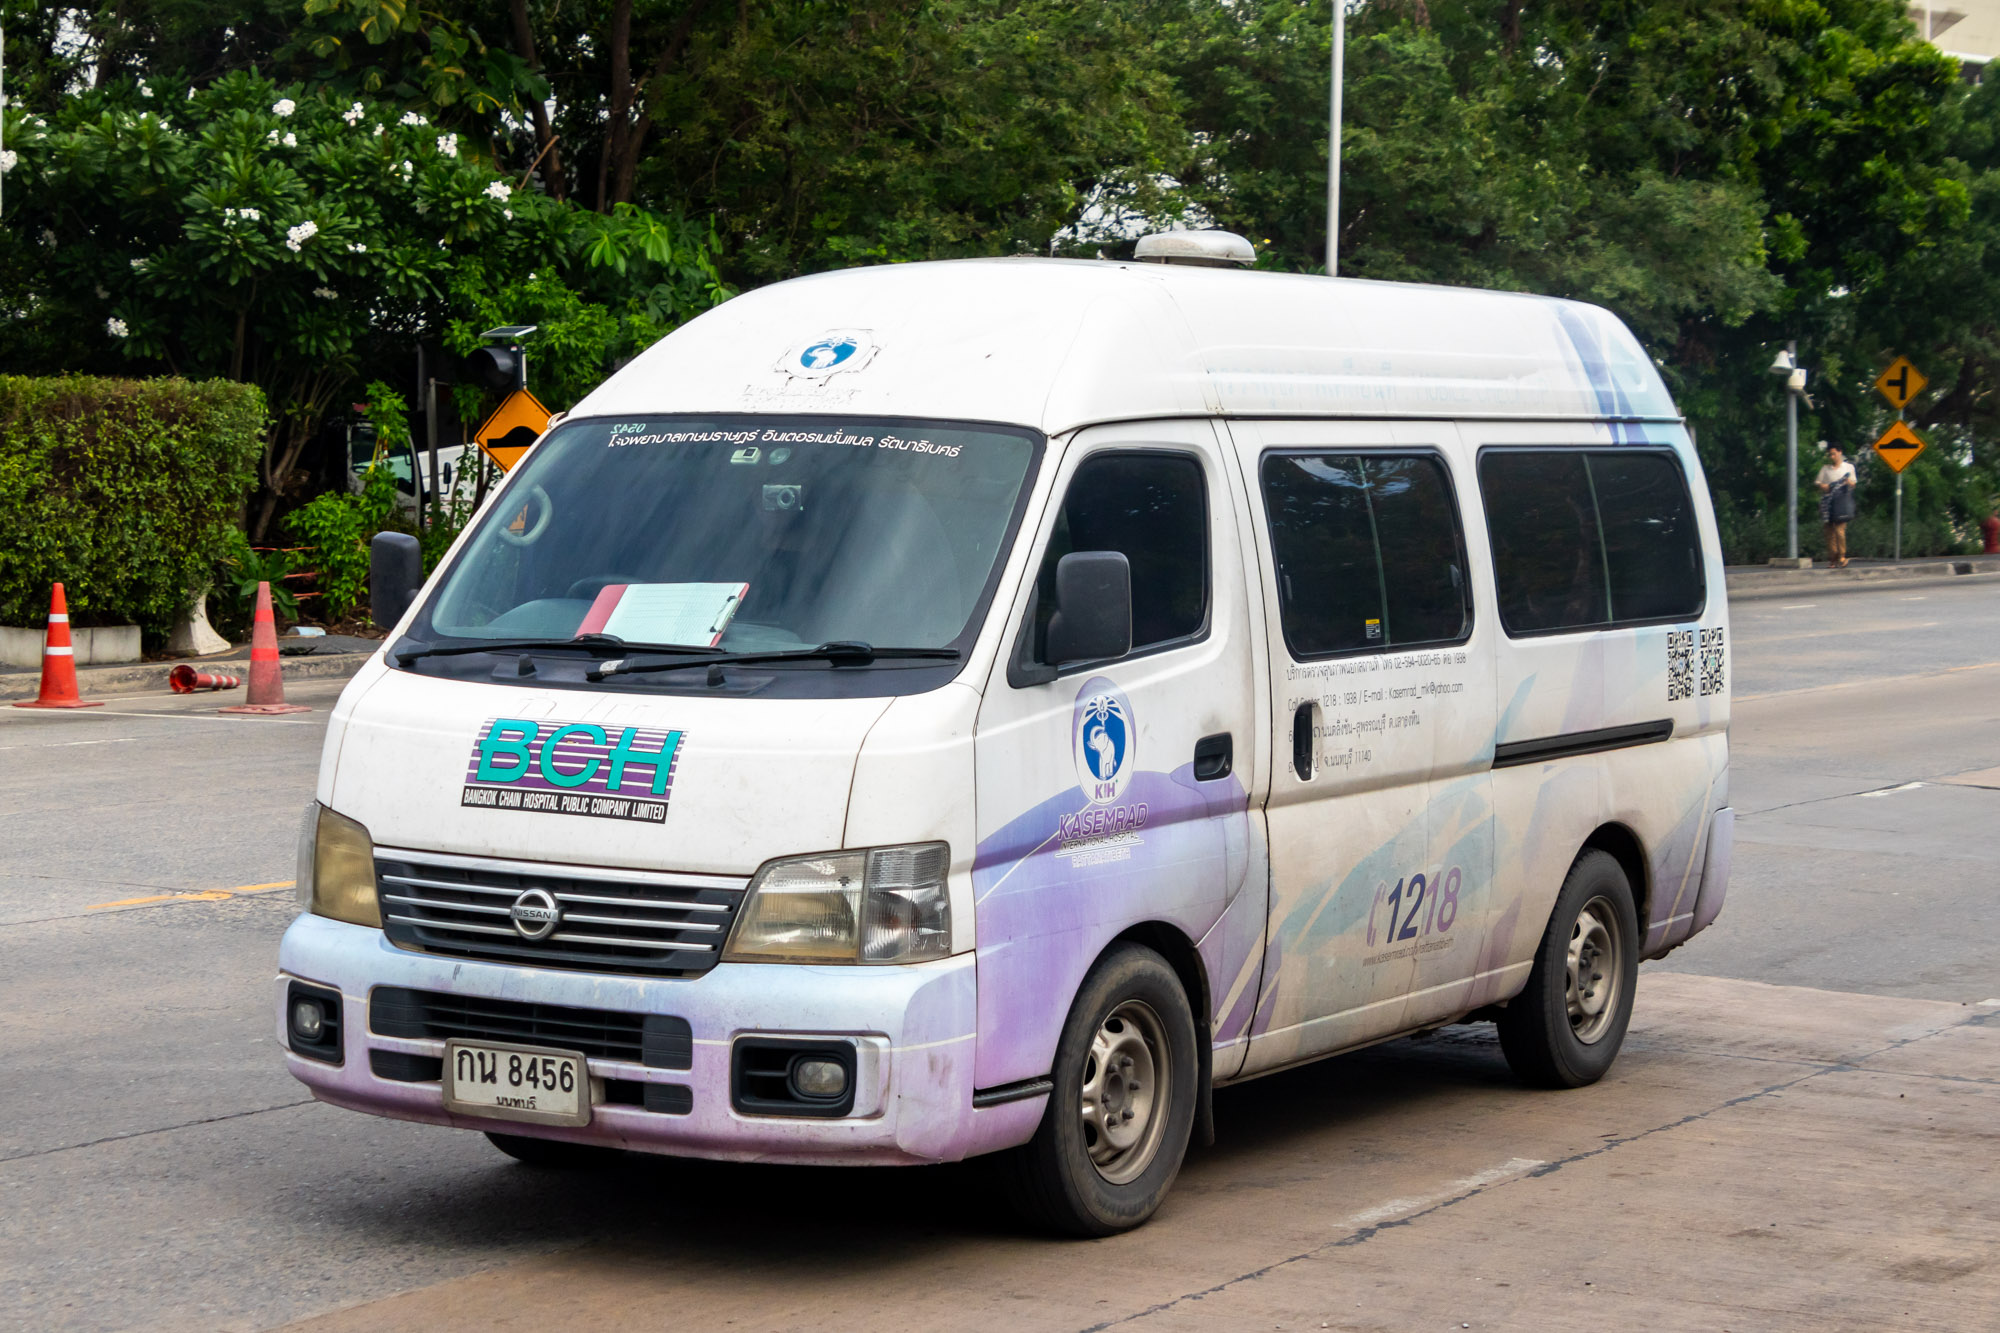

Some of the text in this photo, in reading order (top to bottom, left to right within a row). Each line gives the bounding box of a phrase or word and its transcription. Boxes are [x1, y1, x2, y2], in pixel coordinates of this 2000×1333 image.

[878, 435, 964, 457] รัตนาธิเบศร์
[1323, 693, 1337, 707] 1218
[475, 718, 684, 795] BCH
[1094, 782, 1116, 799] KIH
[463, 788, 666, 821] BANGKOK CHAIN HOSPITAL PUBLIC COMPANY LIMITED
[1058, 803, 1149, 841] KASEMRAD
[1061, 831, 1139, 850] INTERNATIONAL HOSPITAL
[513, 908, 552, 919] NISSAN
[1387, 867, 1462, 944] 1218
[457, 1049, 574, 1093] กน 8456
